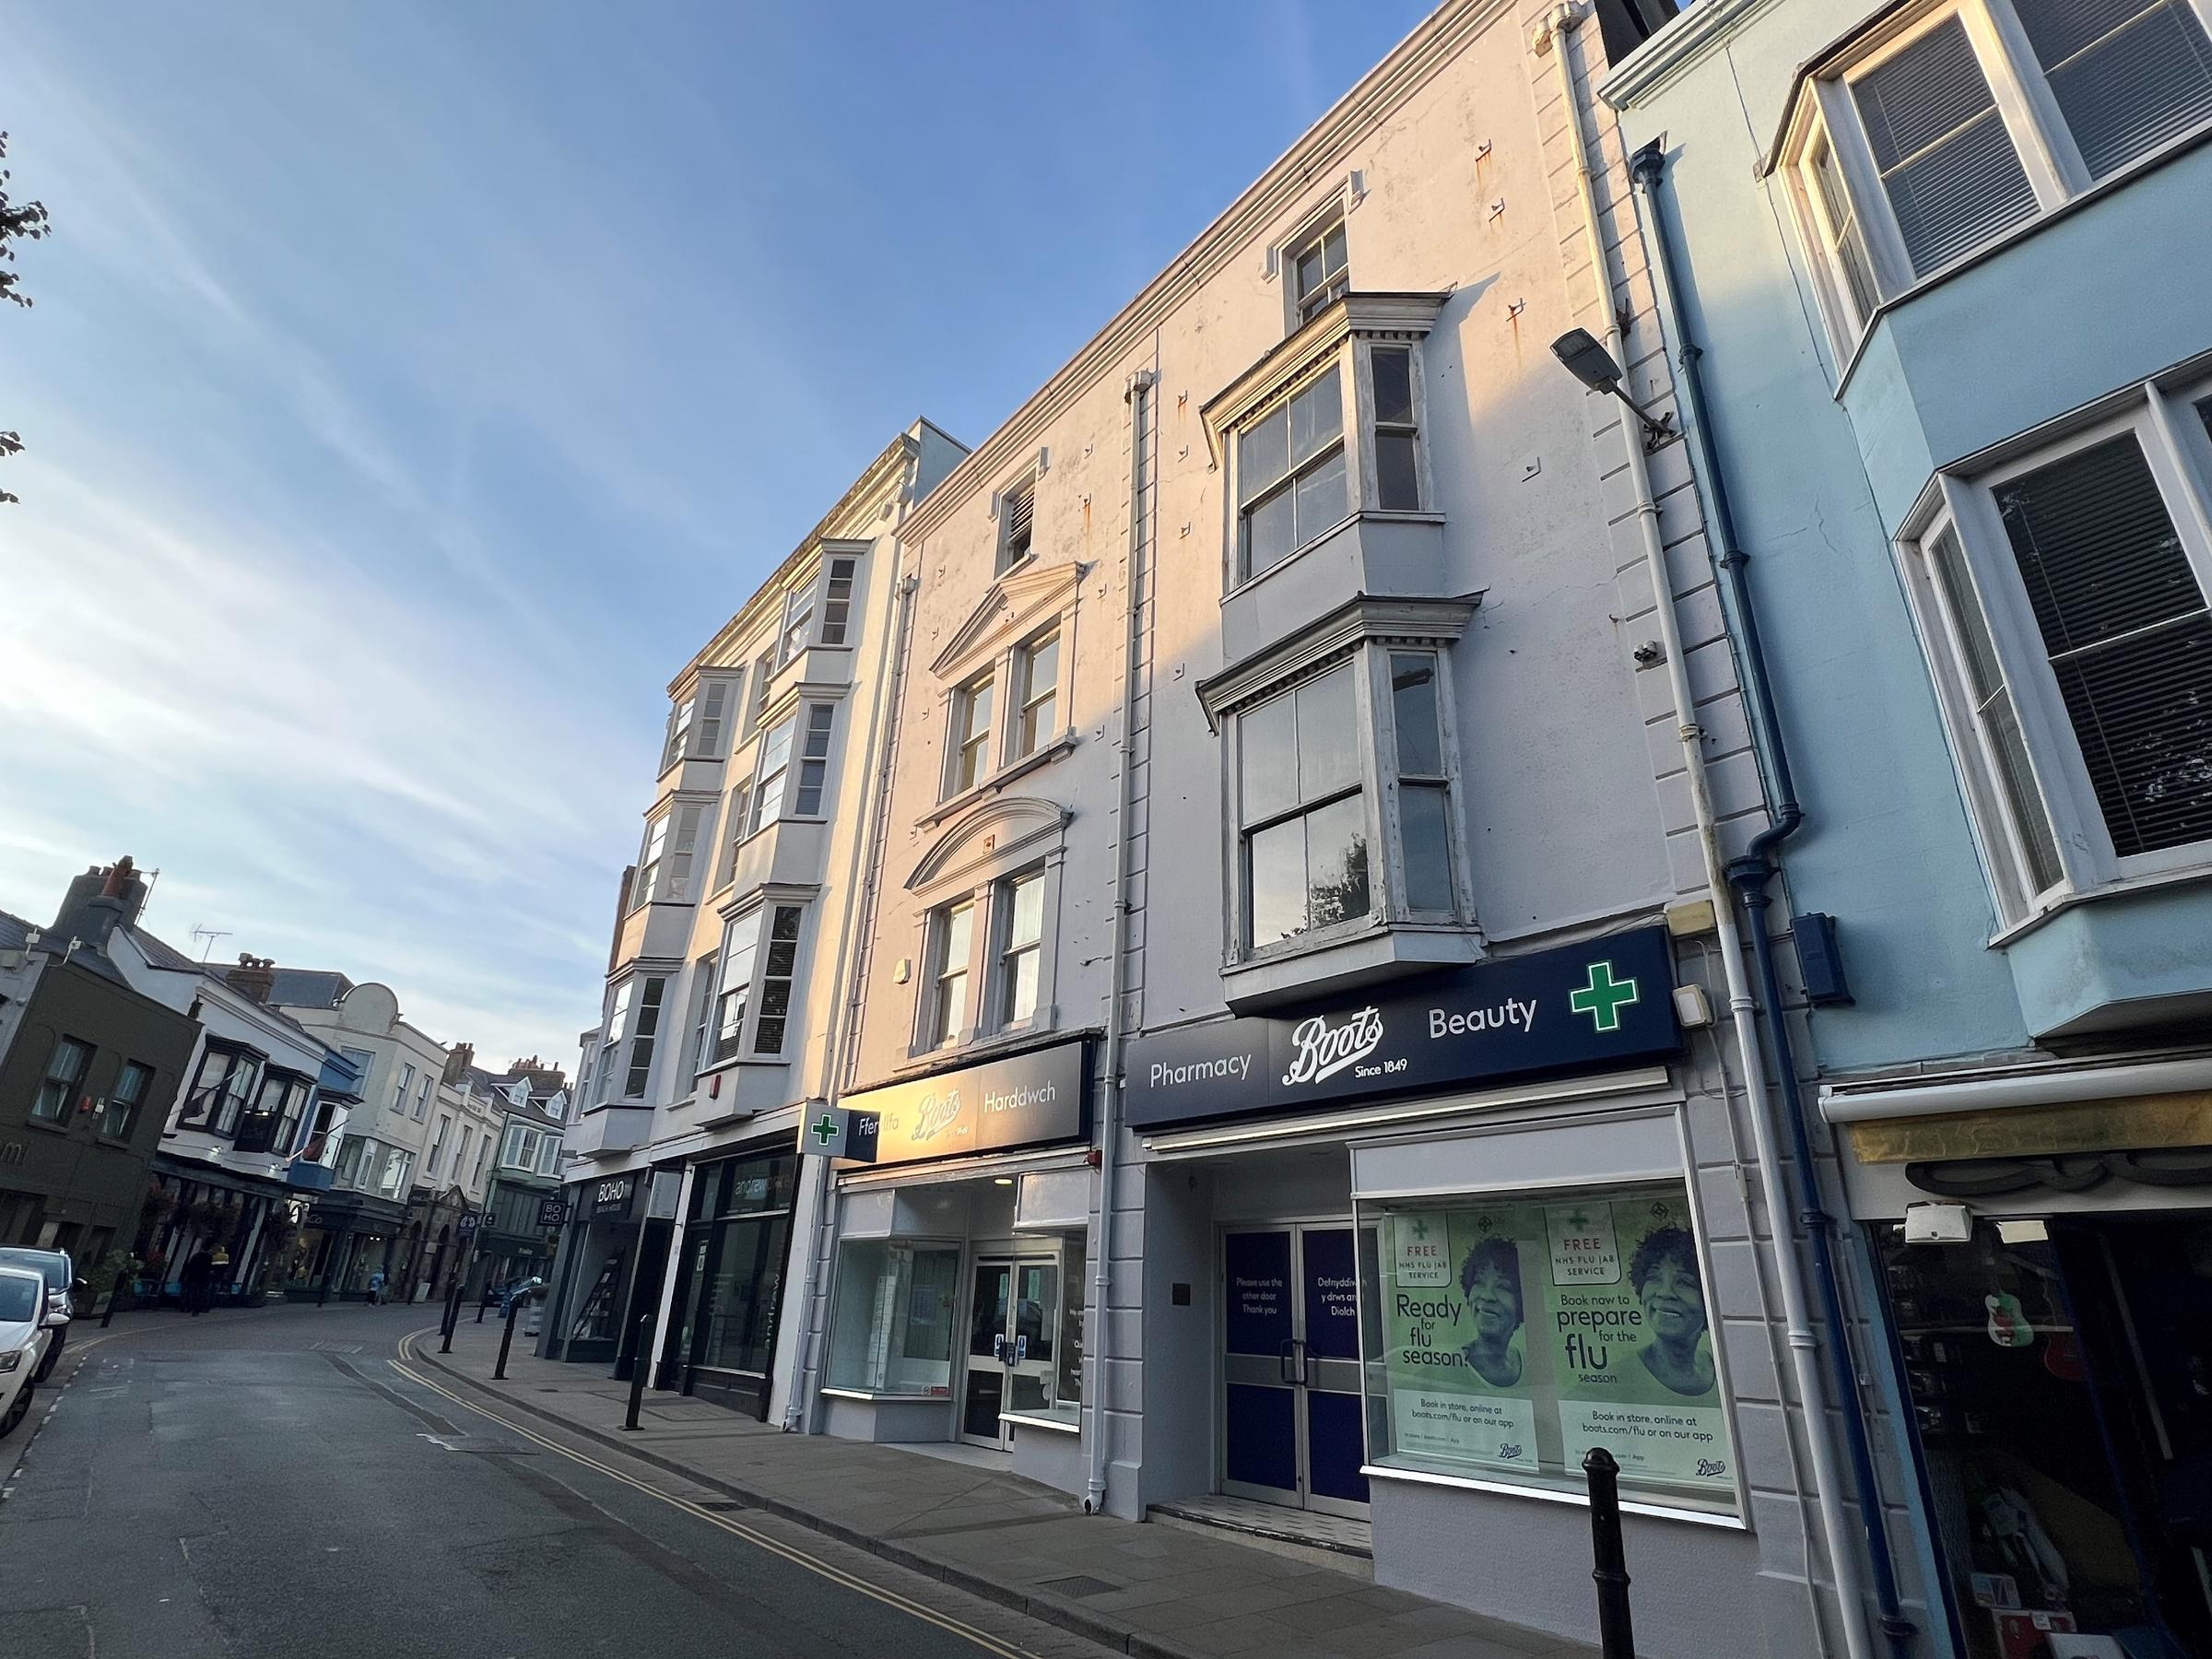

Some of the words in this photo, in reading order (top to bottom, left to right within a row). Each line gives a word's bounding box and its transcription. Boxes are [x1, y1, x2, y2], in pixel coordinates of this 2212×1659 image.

[1429, 997, 1537, 1039] Beauty
[1282, 1006, 1383, 1086] Boots
[1150, 1053, 1252, 1088] Pharmacy
[1355, 1065, 1382, 1078] Since
[1383, 1058, 1408, 1075] 1849
[984, 1079, 1056, 1113] Harddwch
[912, 1088, 961, 1141] Boots
[598, 1181, 625, 1203] BOHO
[546, 1205, 561, 1213] BO
[544, 1213, 559, 1222] HO
[1407, 1246, 1437, 1256] FREE
[1563, 1238, 1601, 1251] FREE
[1434, 1262, 1447, 1270] JAB
[1599, 1255, 1614, 1265] JAB
[1567, 1267, 1605, 1276] SERVICE
[1236, 1277, 1258, 1287] Please
[1271, 1277, 1282, 1287] the
[1242, 1292, 1260, 1300] other
[1261, 1292, 1277, 1300] door
[1321, 1294, 1326, 1304] y
[1327, 1292, 1346, 1302] drws
[1560, 1294, 1589, 1306] Book
[1592, 1297, 1615, 1305] now
[1618, 1295, 1630, 1305] to
[1242, 1304, 1264, 1313] Thank
[1265, 1307, 1277, 1316] you
[1331, 1306, 1356, 1316] Diolch
[1396, 1294, 1462, 1326] Ready
[1421, 1318, 1435, 1330] for
[1557, 1311, 1642, 1333] prepare
[1410, 1327, 1431, 1347] flu
[1599, 1330, 1614, 1342] for
[1617, 1330, 1637, 1342] the
[1565, 1333, 1608, 1370] flu
[1578, 1373, 1617, 1383] season
[1420, 1398, 1439, 1408] Book
[1448, 1403, 1468, 1412] store,
[1470, 1404, 1492, 1414] online
[1494, 1406, 1502, 1415] at
[1412, 1409, 1462, 1423] boots.com/flu
[1484, 1418, 1497, 1426] our
[1498, 1419, 1514, 1429] app
[1592, 1410, 1614, 1421] Book
[1627, 1414, 1653, 1424] store,
[1654, 1416, 1683, 1426] online
[1686, 1418, 1697, 1427] at
[1583, 1423, 1645, 1436] boots.com/flu
[1673, 1431, 1690, 1439] our
[1692, 1432, 1713, 1443] app
[1499, 1443, 1522, 1459] Boots
[1696, 1458, 1726, 1477] Boots
